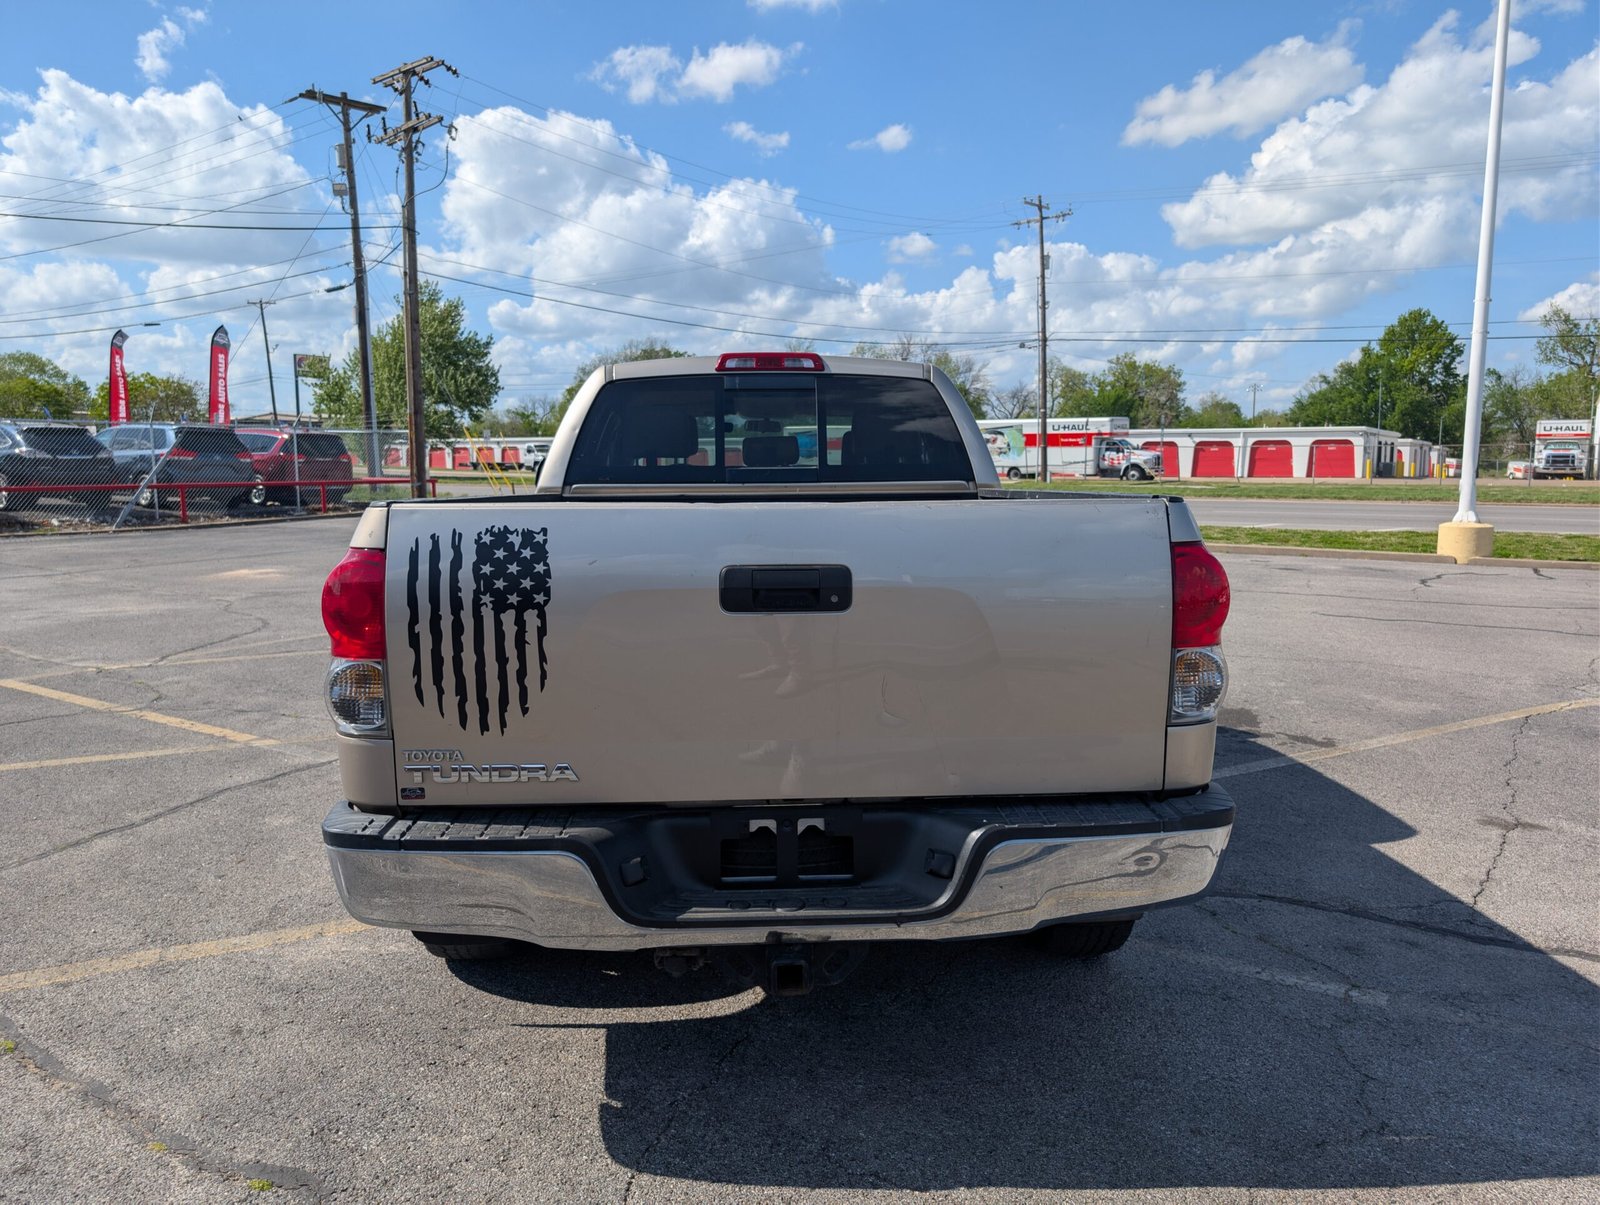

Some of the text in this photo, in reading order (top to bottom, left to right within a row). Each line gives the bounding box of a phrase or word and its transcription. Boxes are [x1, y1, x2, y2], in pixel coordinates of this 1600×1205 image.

[117, 377, 125, 399] AUTO
[218, 379, 226, 403] AUTO
[403, 750, 464, 762] TOYOTA
[403, 763, 580, 784] TUNDRA
